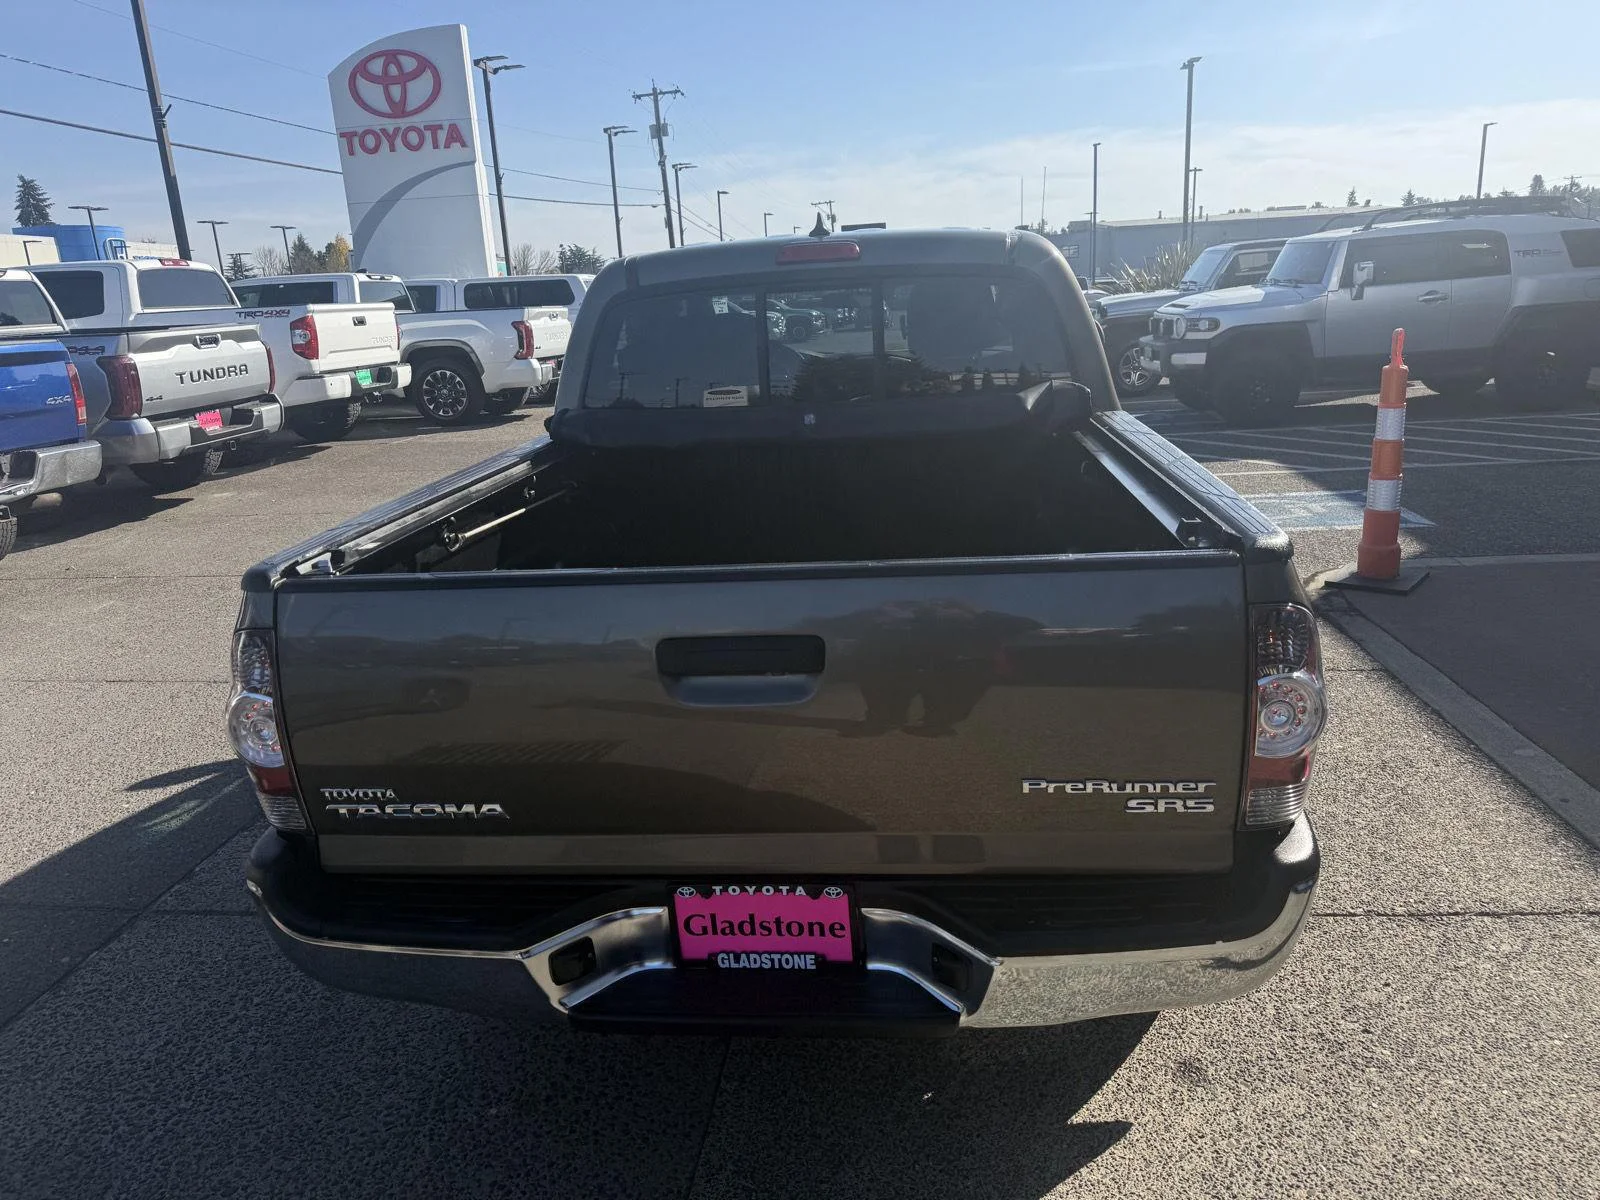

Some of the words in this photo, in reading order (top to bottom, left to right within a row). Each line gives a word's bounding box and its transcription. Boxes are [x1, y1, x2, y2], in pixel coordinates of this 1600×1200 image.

[339, 123, 468, 156] TOYOTA
[174, 364, 249, 385] TUNDRA
[320, 788, 399, 801] TOYOTA
[1022, 779, 1217, 794] PreRunner
[325, 803, 511, 820] TACOMA
[1125, 797, 1215, 813] SR5
[711, 885, 807, 896] TOYOTA
[683, 912, 847, 939] Gladstone
[717, 952, 817, 970] GLADSTONE
